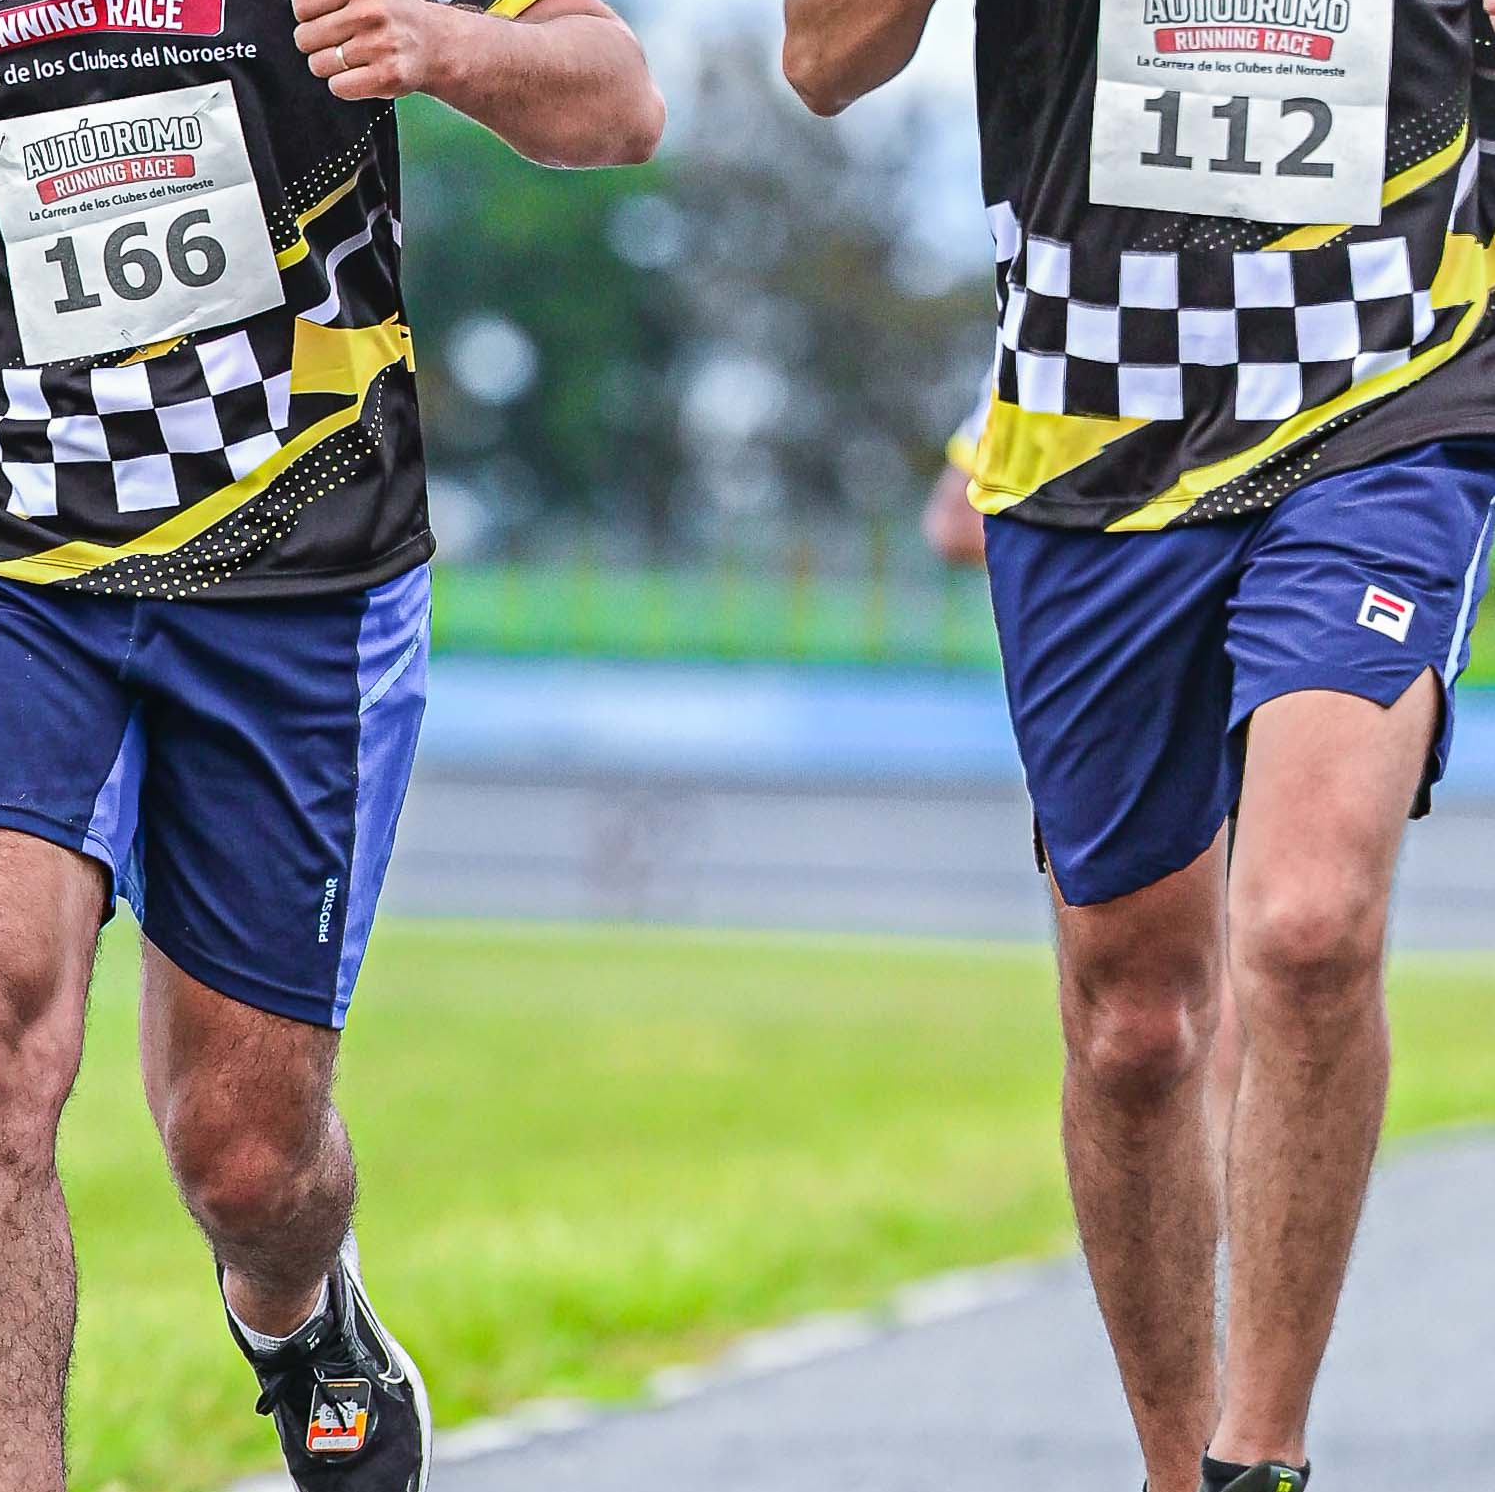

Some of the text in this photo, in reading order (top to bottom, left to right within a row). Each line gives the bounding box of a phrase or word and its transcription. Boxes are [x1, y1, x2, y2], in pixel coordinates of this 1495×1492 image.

[4, 63, 31, 85] de
[33, 58, 66, 80] los
[68, 48, 129, 72] Clubes
[131, 46, 160, 68] del
[163, 41, 257, 65] Noroeste
[1174, 29, 1313, 56] RUNNING RACE
[1137, 55, 1346, 78] La Carrera de los Clubes del Noroeste
[23, 116, 203, 181] AUTÓDROMO
[1140, 90, 1334, 179] 112
[29, 178, 215, 221] La Carrera de los Clubes del Noroeste
[53, 158, 177, 198] RUNNING RACE
[45, 209, 227, 314] 166
[318, 877, 339, 944] PROSTAR
